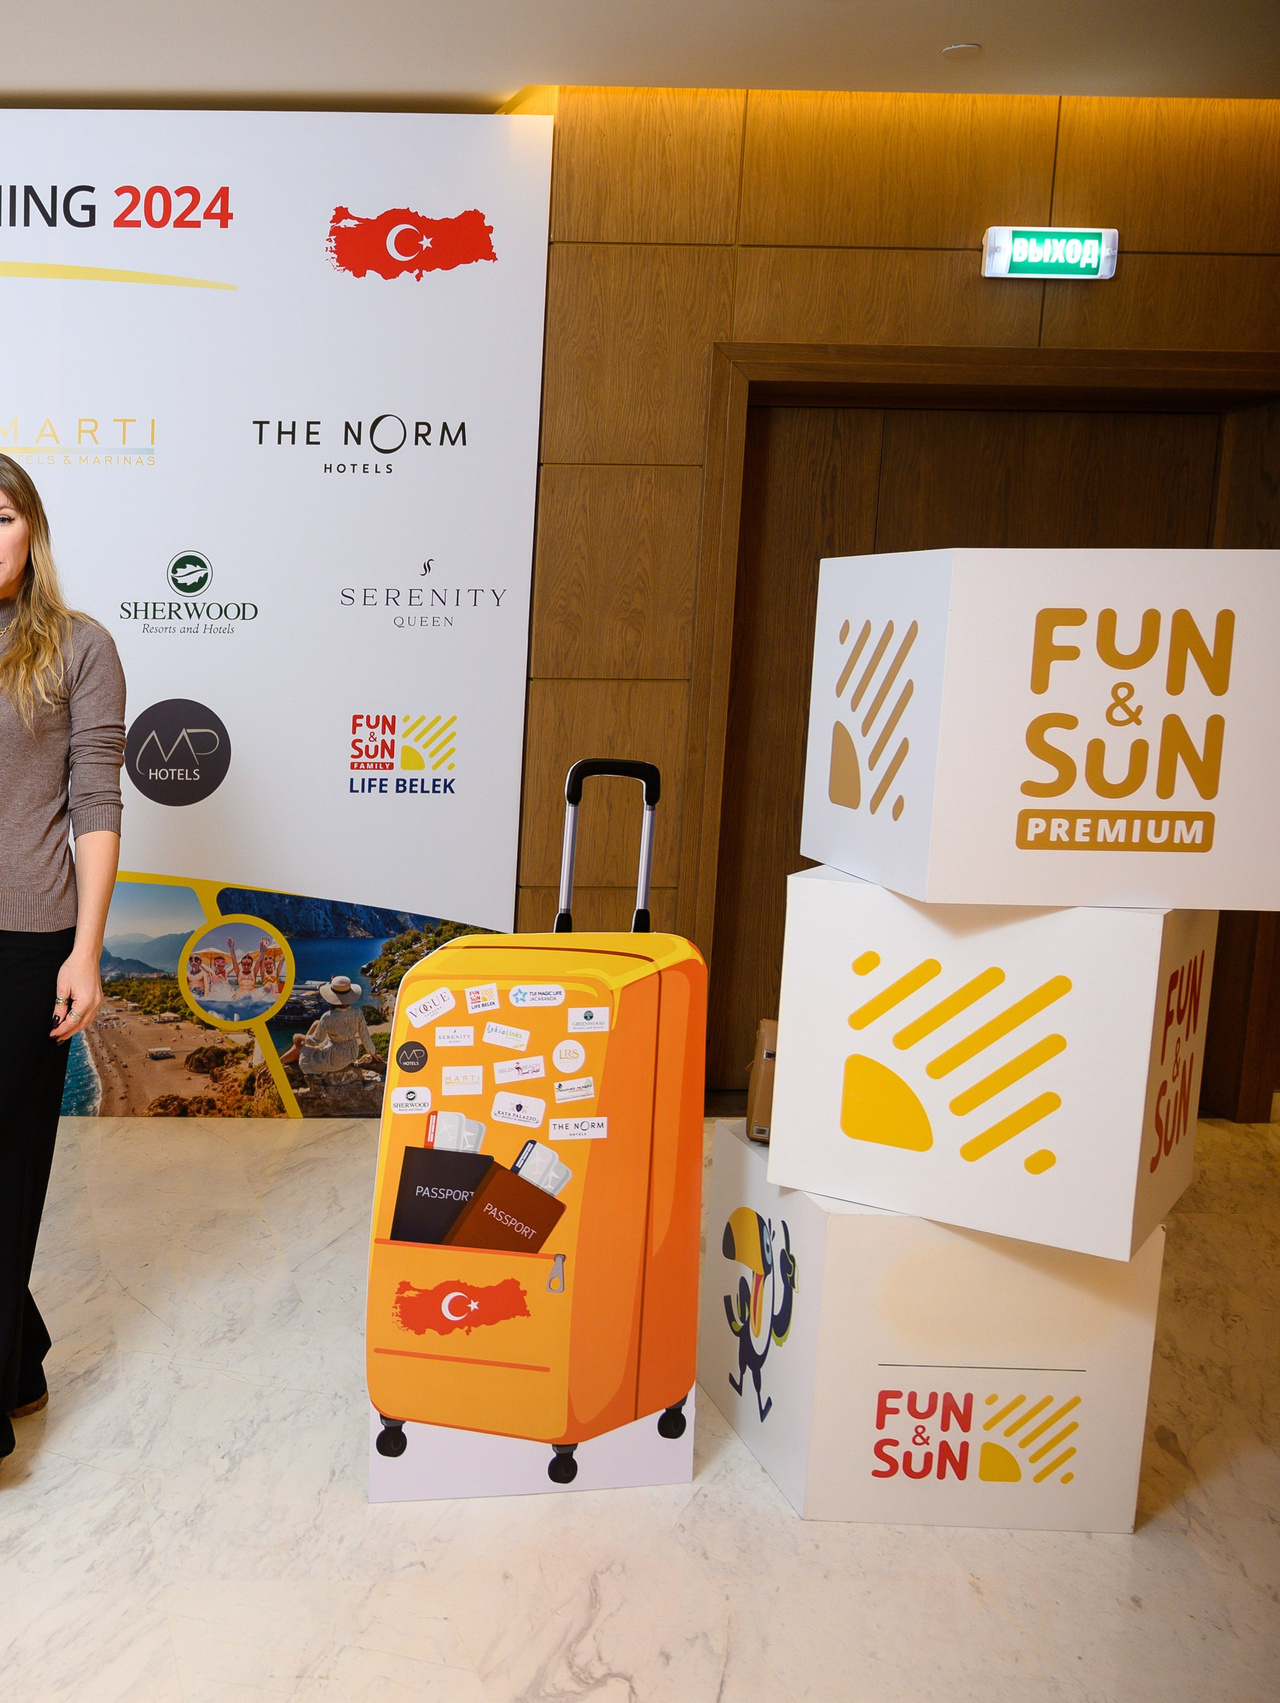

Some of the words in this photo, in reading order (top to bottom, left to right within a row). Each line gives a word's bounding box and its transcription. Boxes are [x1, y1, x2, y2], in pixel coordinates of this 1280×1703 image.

[113, 185, 234, 229] 2024
[1012, 238, 1099, 268] ВЫХОД
[253, 420, 321, 447] THE
[344, 414, 467, 454] NORM
[16, 455, 55, 465] TELS
[63, 455, 72, 465] &
[79, 455, 156, 466] MARINAS
[324, 463, 393, 474] HOTELS
[340, 588, 507, 607] SERENITY
[119, 602, 258, 621] SHERWOOD
[393, 616, 455, 628] QUEEN
[141, 623, 177, 634] Resorts
[179, 623, 199, 634] and
[202, 623, 235, 635] Hotels
[1030, 608, 1235, 696] FUN
[1105, 681, 1144, 727] &
[351, 714, 396, 736] FUN
[368, 731, 377, 743] &
[350, 738, 395, 760] SUN
[1020, 712, 1226, 800] SUN
[148, 768, 200, 781] HOTELS
[353, 762, 391, 770] FAMILY
[349, 777, 389, 794] LIFE
[395, 778, 456, 794] BELEK
[1027, 817, 1204, 844] PREMIUM
[409, 992, 450, 1018] VOGUE
[1161, 949, 1205, 1066] FUN
[574, 1121, 604, 1131] NORM
[483, 1203, 537, 1240] PASSPORT
[875, 1390, 974, 1433] FUN
[912, 1425, 930, 1446] &
[871, 1440, 969, 1481] SUN
